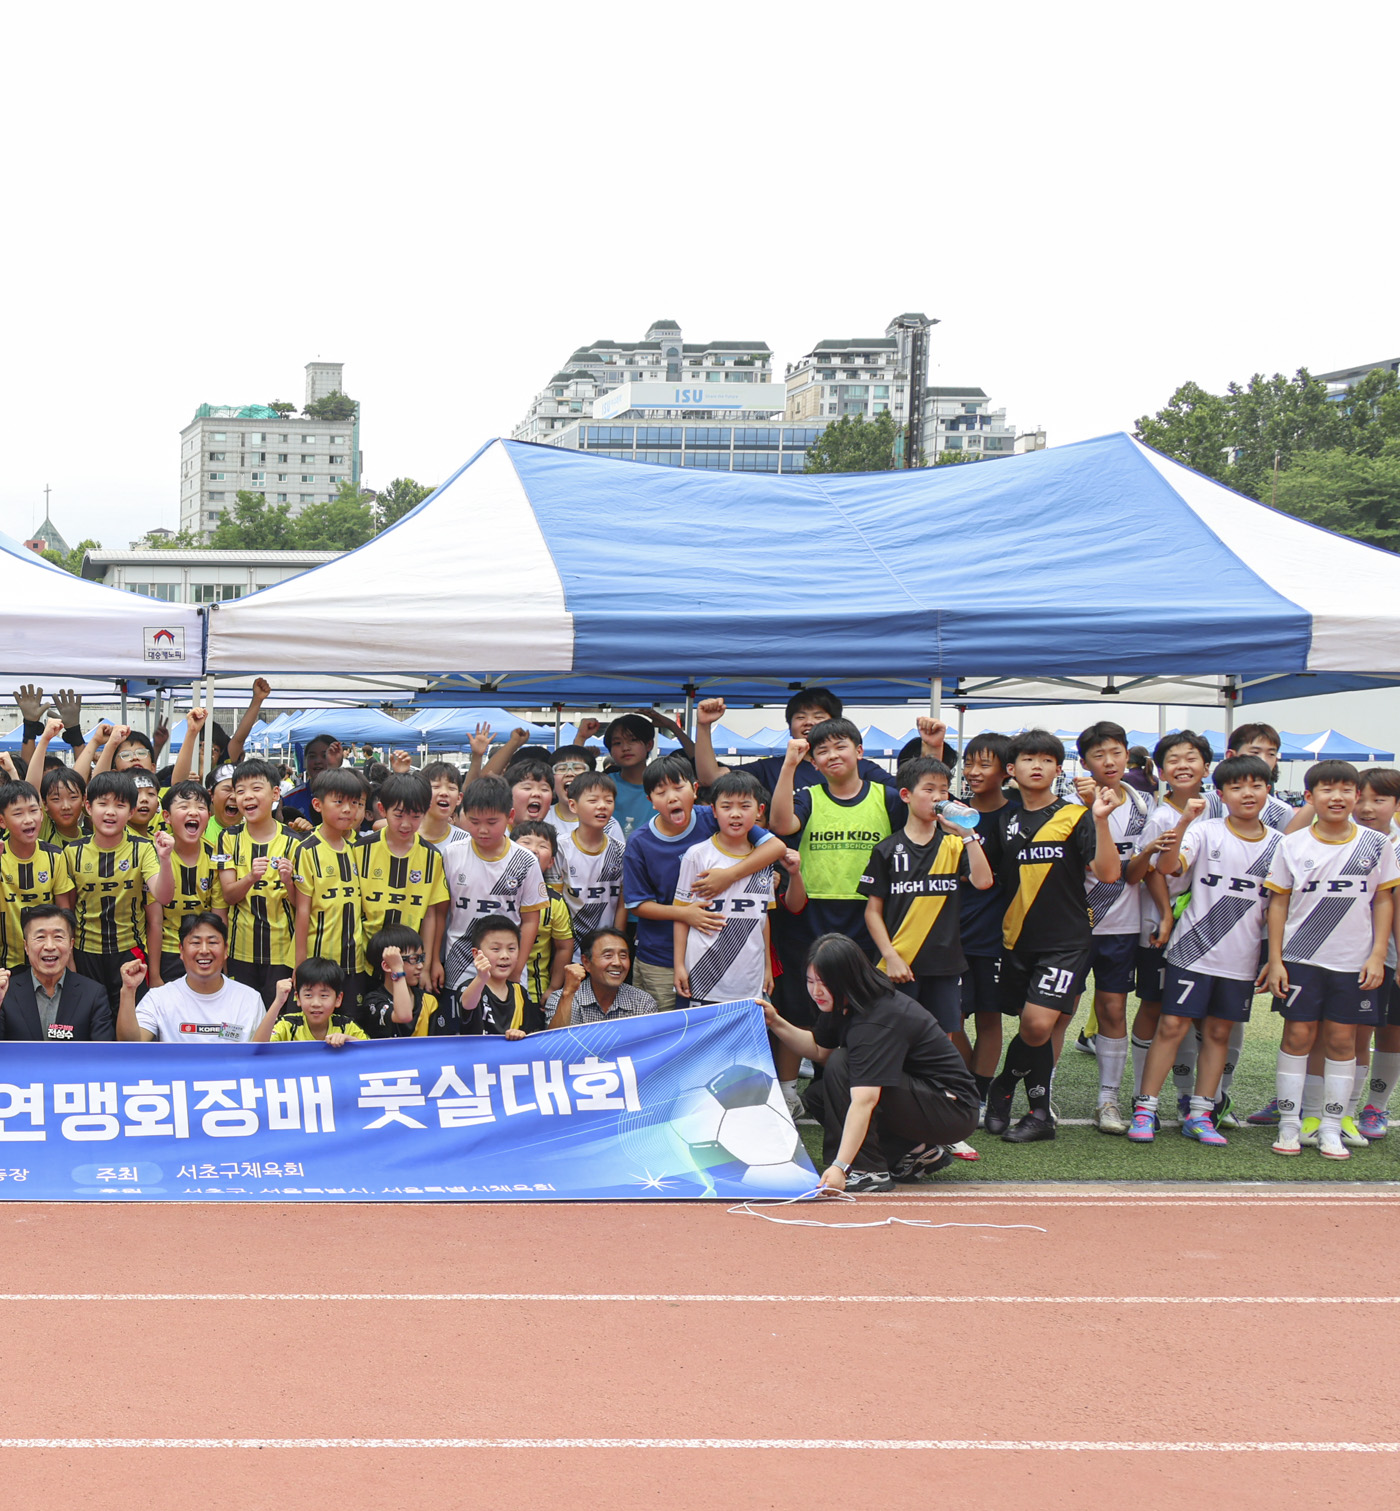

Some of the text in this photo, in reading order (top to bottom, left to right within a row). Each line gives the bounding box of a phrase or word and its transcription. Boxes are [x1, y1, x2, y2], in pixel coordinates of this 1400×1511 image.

[675, 389, 703, 403] ISU
[893, 853, 909, 872] 11
[82, 880, 133, 892] JPI
[254, 878, 284, 890] PI
[1201, 873, 1269, 898] JPI
[1302, 880, 1367, 892] JPI
[5, 892, 51, 903] JPI
[365, 892, 423, 905] JPI
[567, 886, 621, 899] JPI
[456, 897, 517, 913] JPI
[1038, 966, 1074, 994] 20
[1177, 979, 1195, 1005] 7
[47, 1028, 74, 1040] 전성수
[357, 1056, 642, 1130] 풋살대회
[96, 1162, 305, 1182] 주최 서초구체육회
